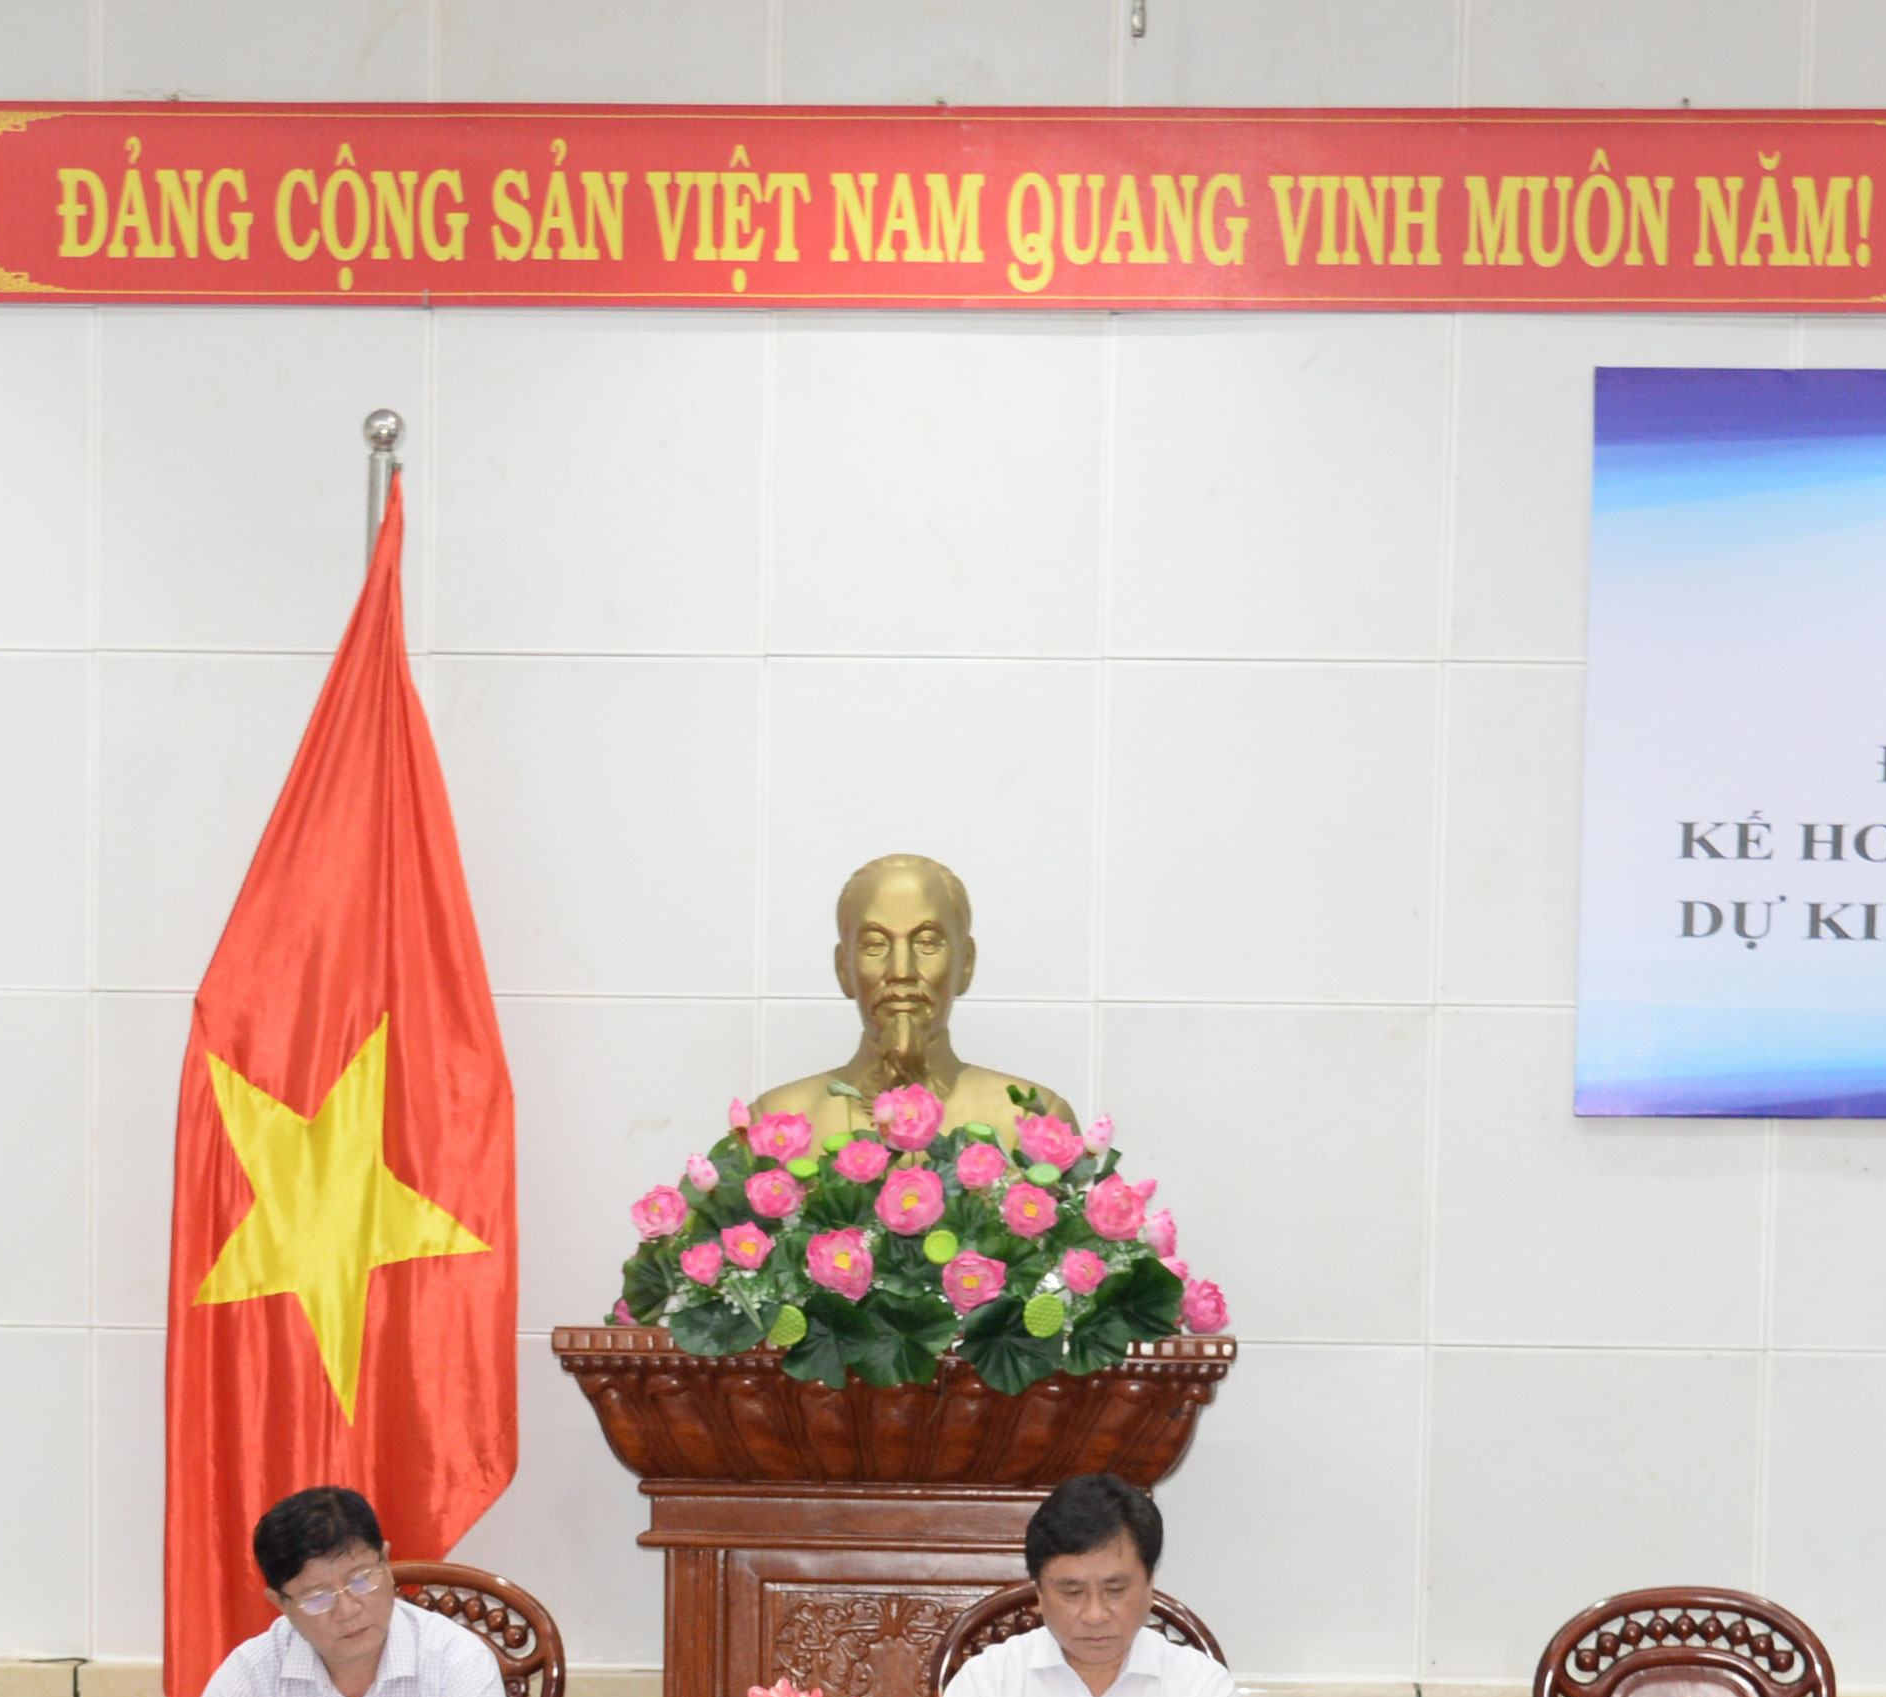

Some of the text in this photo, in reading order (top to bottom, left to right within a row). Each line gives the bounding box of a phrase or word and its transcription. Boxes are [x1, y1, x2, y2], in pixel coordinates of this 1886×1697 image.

[57, 135, 1874, 296] ĐẢNG CỘNG SẢN VIỆT NAM QUANG VINH MUÔN NĂM!
[1677, 811, 1775, 860] KẾ
[1678, 895, 1790, 950] DỰ
